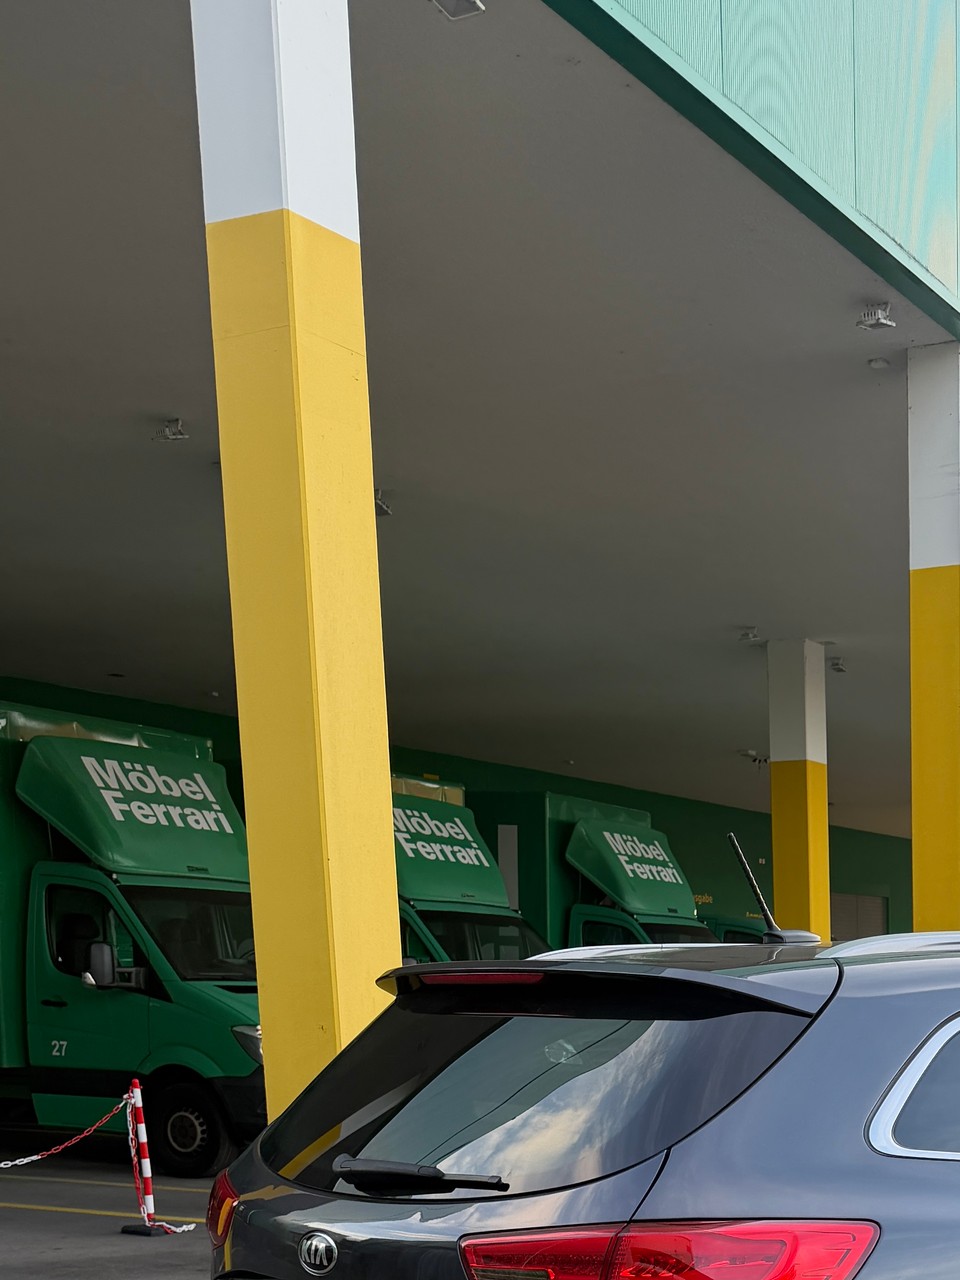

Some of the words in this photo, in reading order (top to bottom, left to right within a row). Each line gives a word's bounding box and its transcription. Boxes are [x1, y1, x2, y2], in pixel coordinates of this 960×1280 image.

[81, 756, 216, 802] Möbel
[100, 789, 234, 834] Ferrari
[395, 832, 490, 867] Ferrari
[603, 831, 669, 862] Möbel
[617, 855, 683, 885] Ferrari
[51, 1040, 68, 1056] 27
